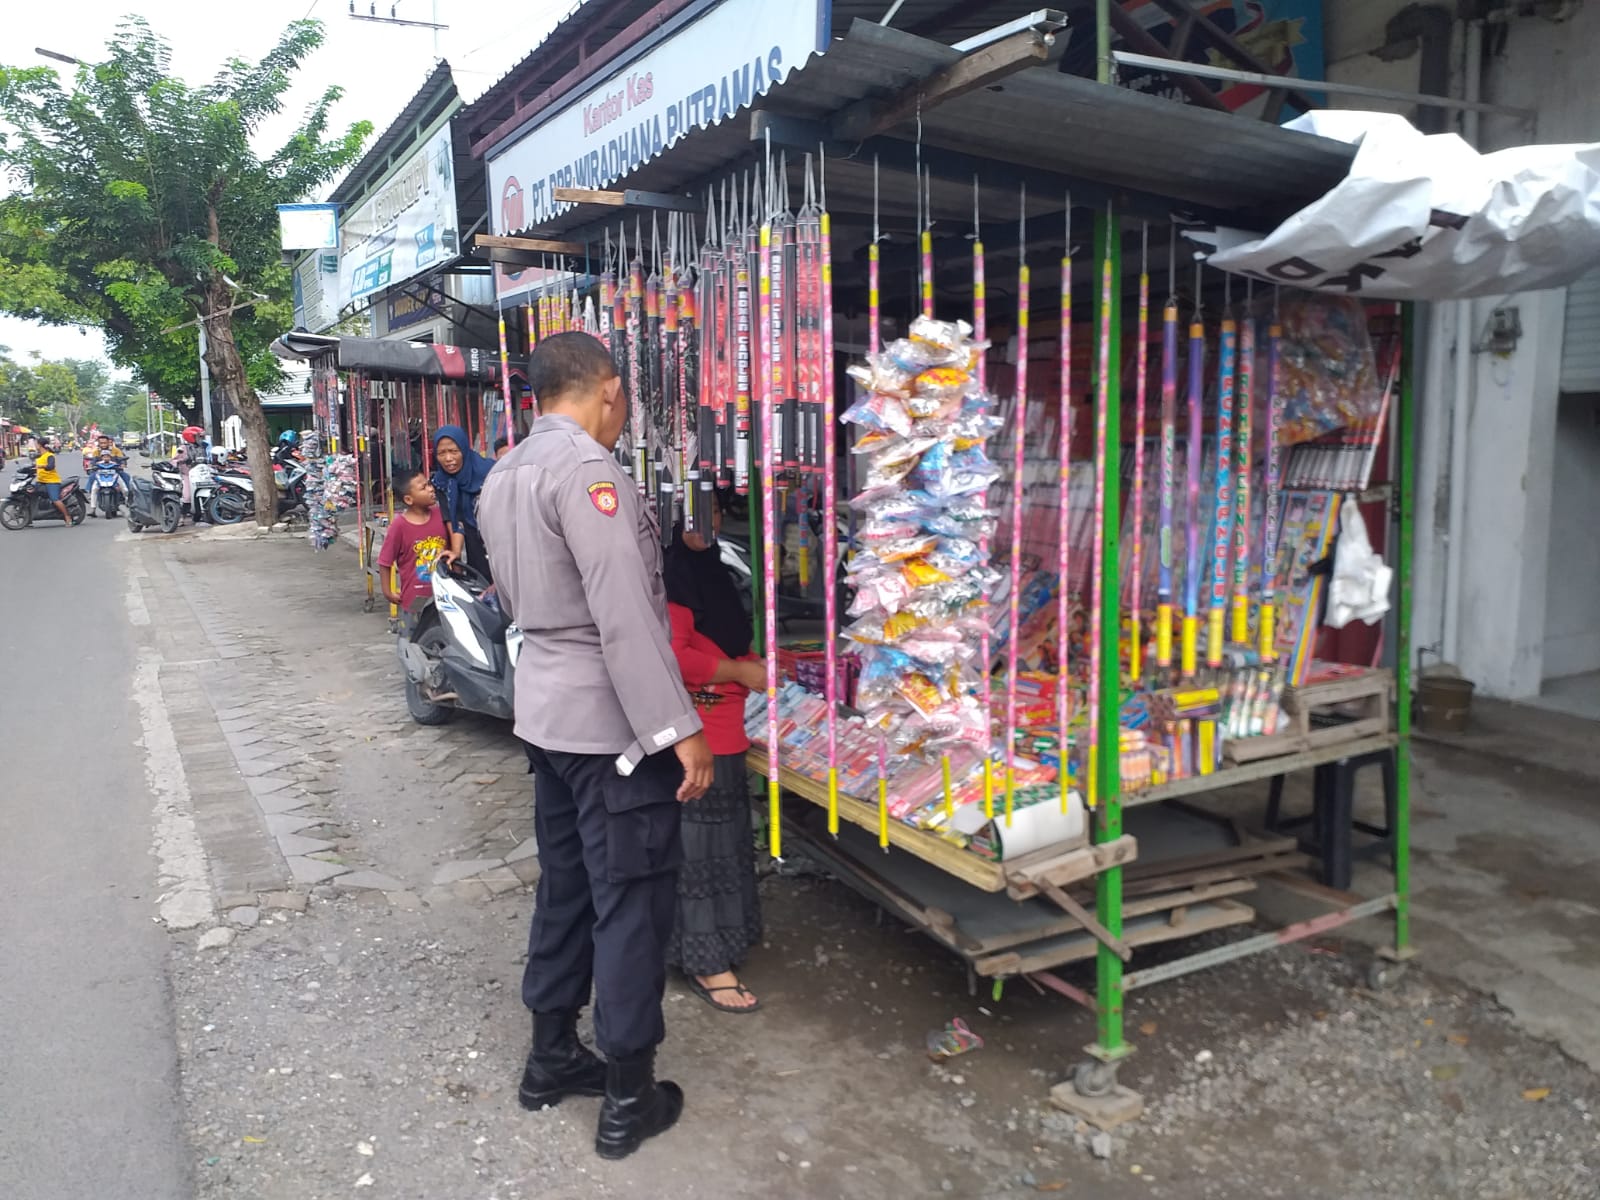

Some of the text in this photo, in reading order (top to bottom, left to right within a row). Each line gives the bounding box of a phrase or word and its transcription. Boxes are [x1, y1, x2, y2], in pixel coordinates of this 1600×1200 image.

[583, 72, 654, 137] Kantor Kas
[575, 114, 662, 187] WIRADHANA
